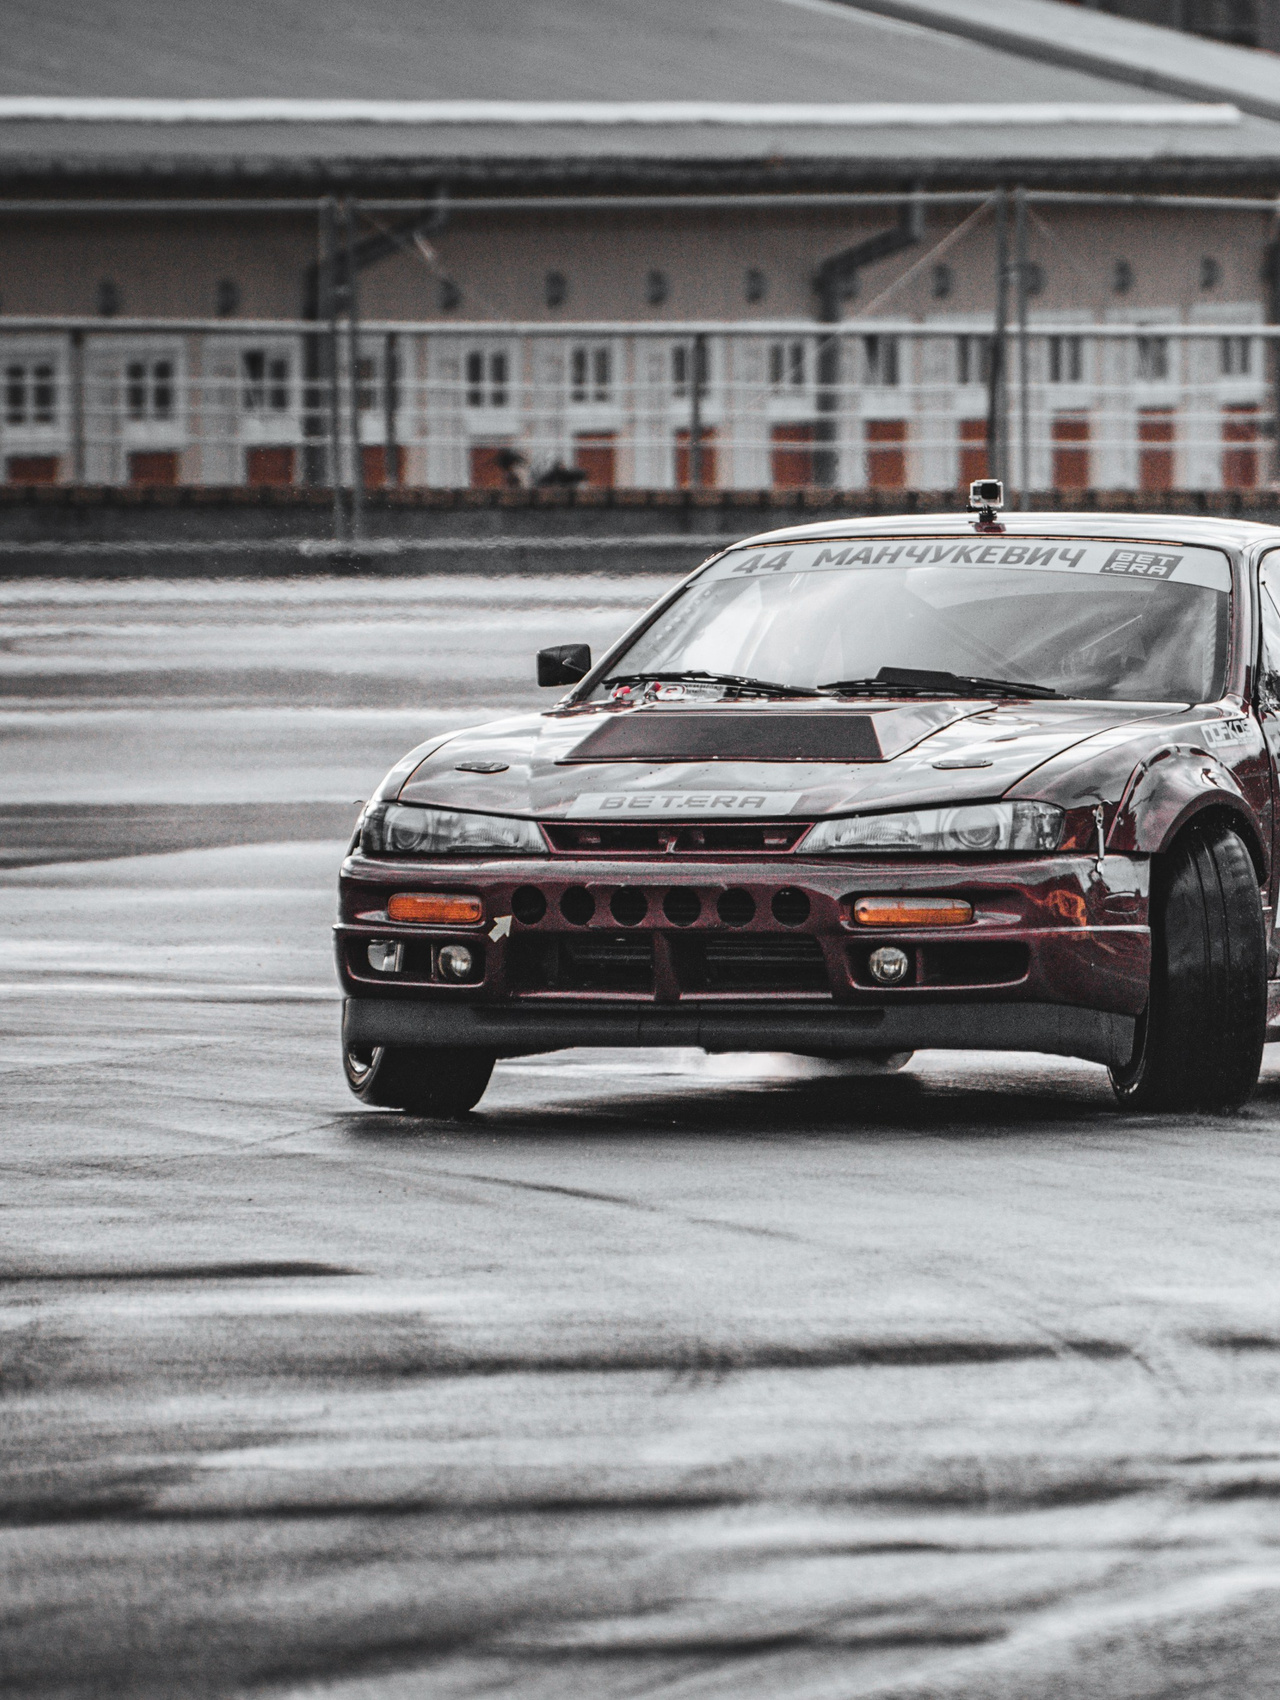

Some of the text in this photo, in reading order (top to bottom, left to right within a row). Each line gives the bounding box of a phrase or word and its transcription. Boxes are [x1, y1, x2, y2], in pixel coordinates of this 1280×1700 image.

[732, 545, 1087, 574] 44 МАНЧУКЕВИЧ
[1115, 552, 1175, 566] BET
[599, 794, 768, 810] BET.ERA
